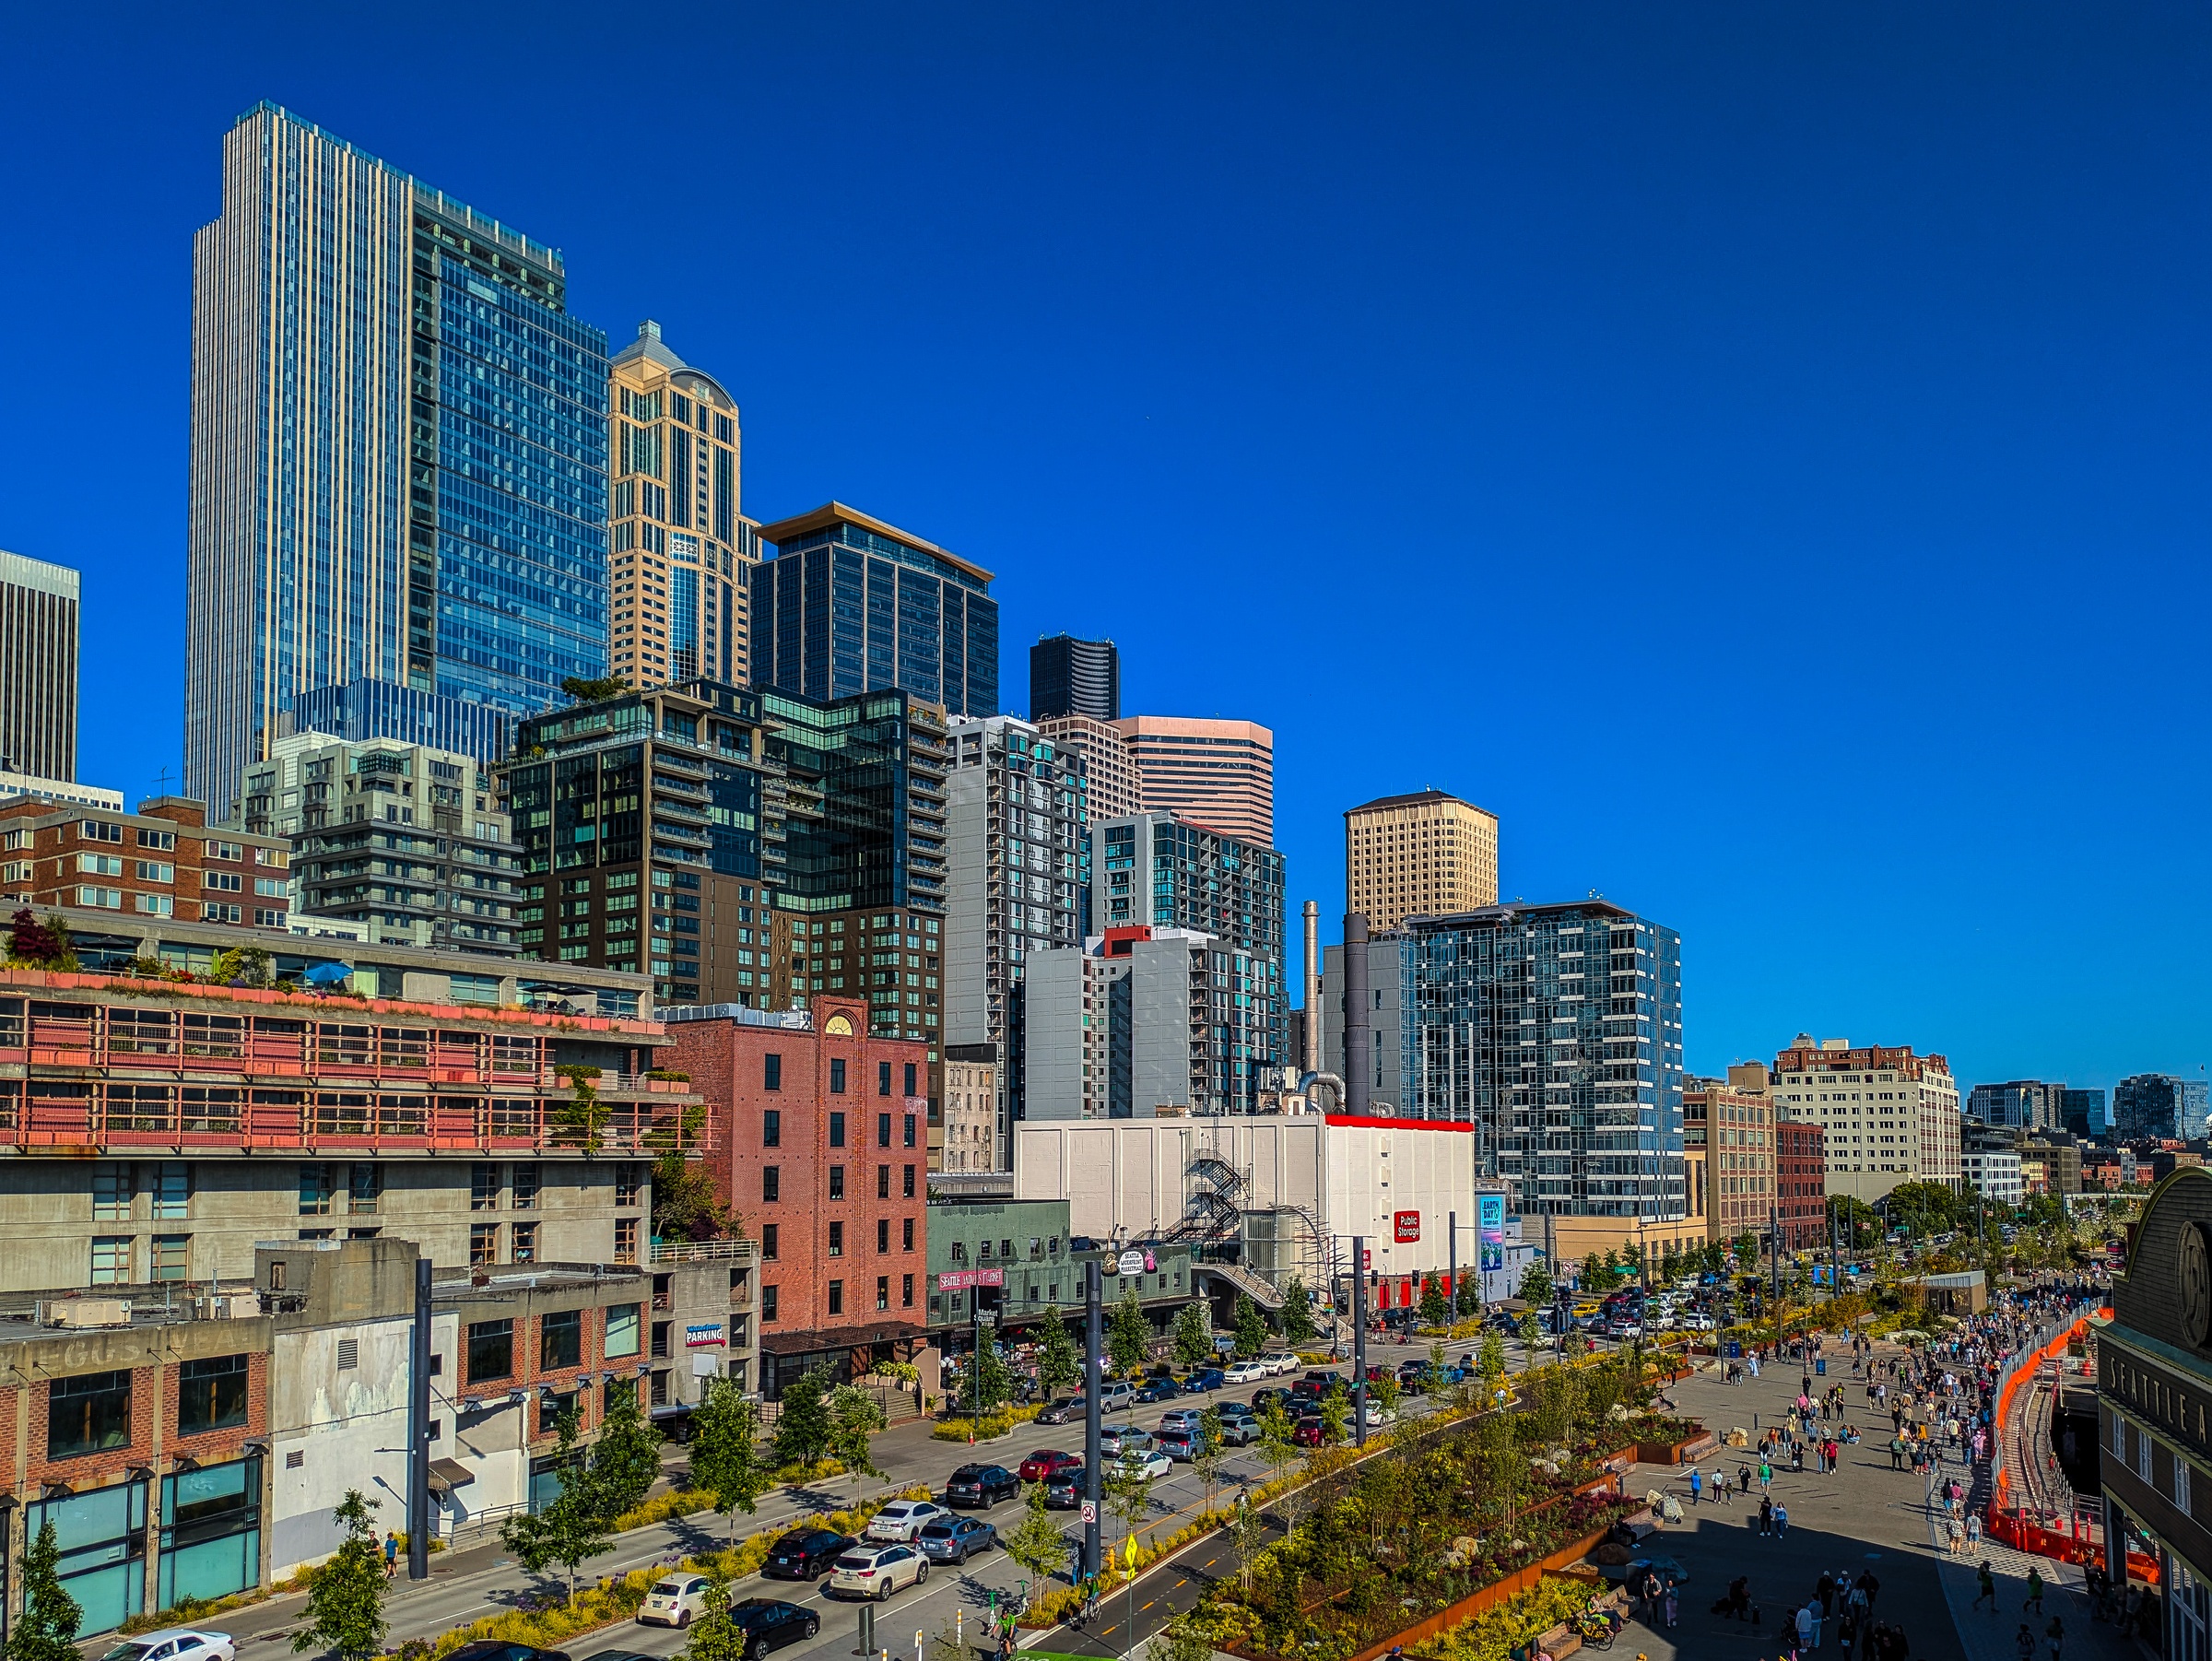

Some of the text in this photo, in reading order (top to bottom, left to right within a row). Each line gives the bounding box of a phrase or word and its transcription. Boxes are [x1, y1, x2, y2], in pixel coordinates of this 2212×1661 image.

[1483, 1209, 1494, 1219] DAY
[1400, 1215, 1418, 1226] Public
[1397, 1226, 1419, 1239] Storage
[940, 1275, 960, 1289] SEATTLE
[973, 1313, 995, 1323] Square
[978, 1308, 998, 1317] Market
[687, 1324, 722, 1332] Waterfront
[686, 1329, 723, 1343] PARKING
[42, 1340, 140, 1372] EGGS
[2111, 1357, 2188, 1432] SEATTLE
